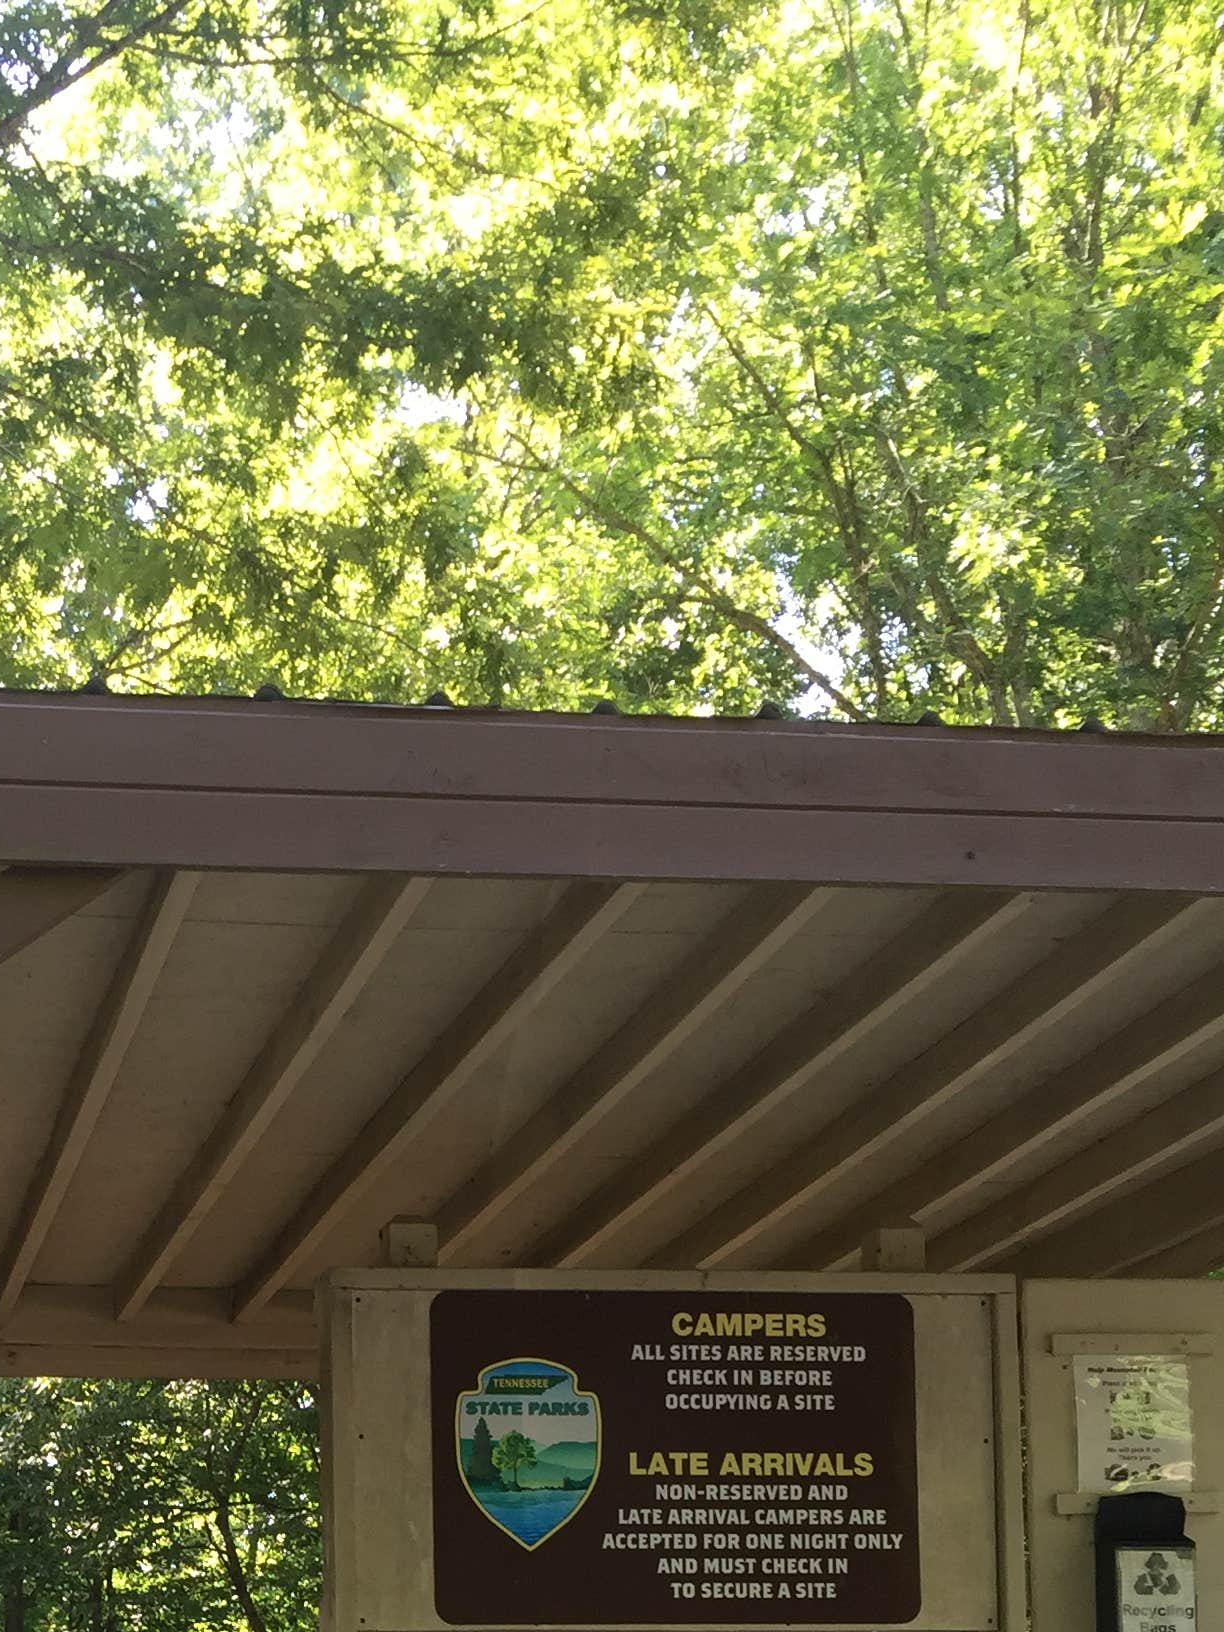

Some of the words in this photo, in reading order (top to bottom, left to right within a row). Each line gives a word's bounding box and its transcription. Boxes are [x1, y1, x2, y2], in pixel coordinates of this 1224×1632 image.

[671, 1312, 826, 1338] CAMPERS
[631, 1344, 665, 1361] ALL
[670, 1344, 722, 1361] SITES
[726, 1345, 765, 1361] ARE
[769, 1345, 866, 1362] RESERVED
[492, 1377, 550, 1389] TENNESSEE
[666, 1369, 728, 1386] CHECK
[733, 1369, 753, 1386] IN
[759, 1369, 833, 1386] BEFORE
[465, 1401, 523, 1416] STATE
[528, 1401, 590, 1416] PARKS
[665, 1393, 772, 1410] OCCUPYING
[776, 1394, 790, 1410] A
[794, 1394, 835, 1411] SITE
[629, 1452, 709, 1476] LATE
[719, 1452, 874, 1477] ARRIVALS
[655, 1484, 803, 1501] NON-RESERVED
[807, 1484, 849, 1501] AND
[618, 1508, 663, 1525] LATE
[667, 1508, 750, 1525] ARRIVAL
[754, 1509, 844, 1525] CAMPERS
[848, 1509, 887, 1525] ARE
[602, 1533, 698, 1550] ACCEPTED
[703, 1533, 740, 1550] FOR
[745, 1533, 785, 1550] ONE
[790, 1533, 849, 1550] NIGHT
[854, 1533, 904, 1550] ONLY
[657, 1558, 698, 1574] AND
[703, 1558, 757, 1574] MUST
[761, 1558, 823, 1574] CHECK
[827, 1558, 848, 1574] IN
[670, 1582, 696, 1599] TO
[701, 1582, 774, 1599] SECURE
[777, 1582, 791, 1599] A
[795, 1582, 837, 1599] SITE
[1123, 1603, 1194, 1620] Recycling
